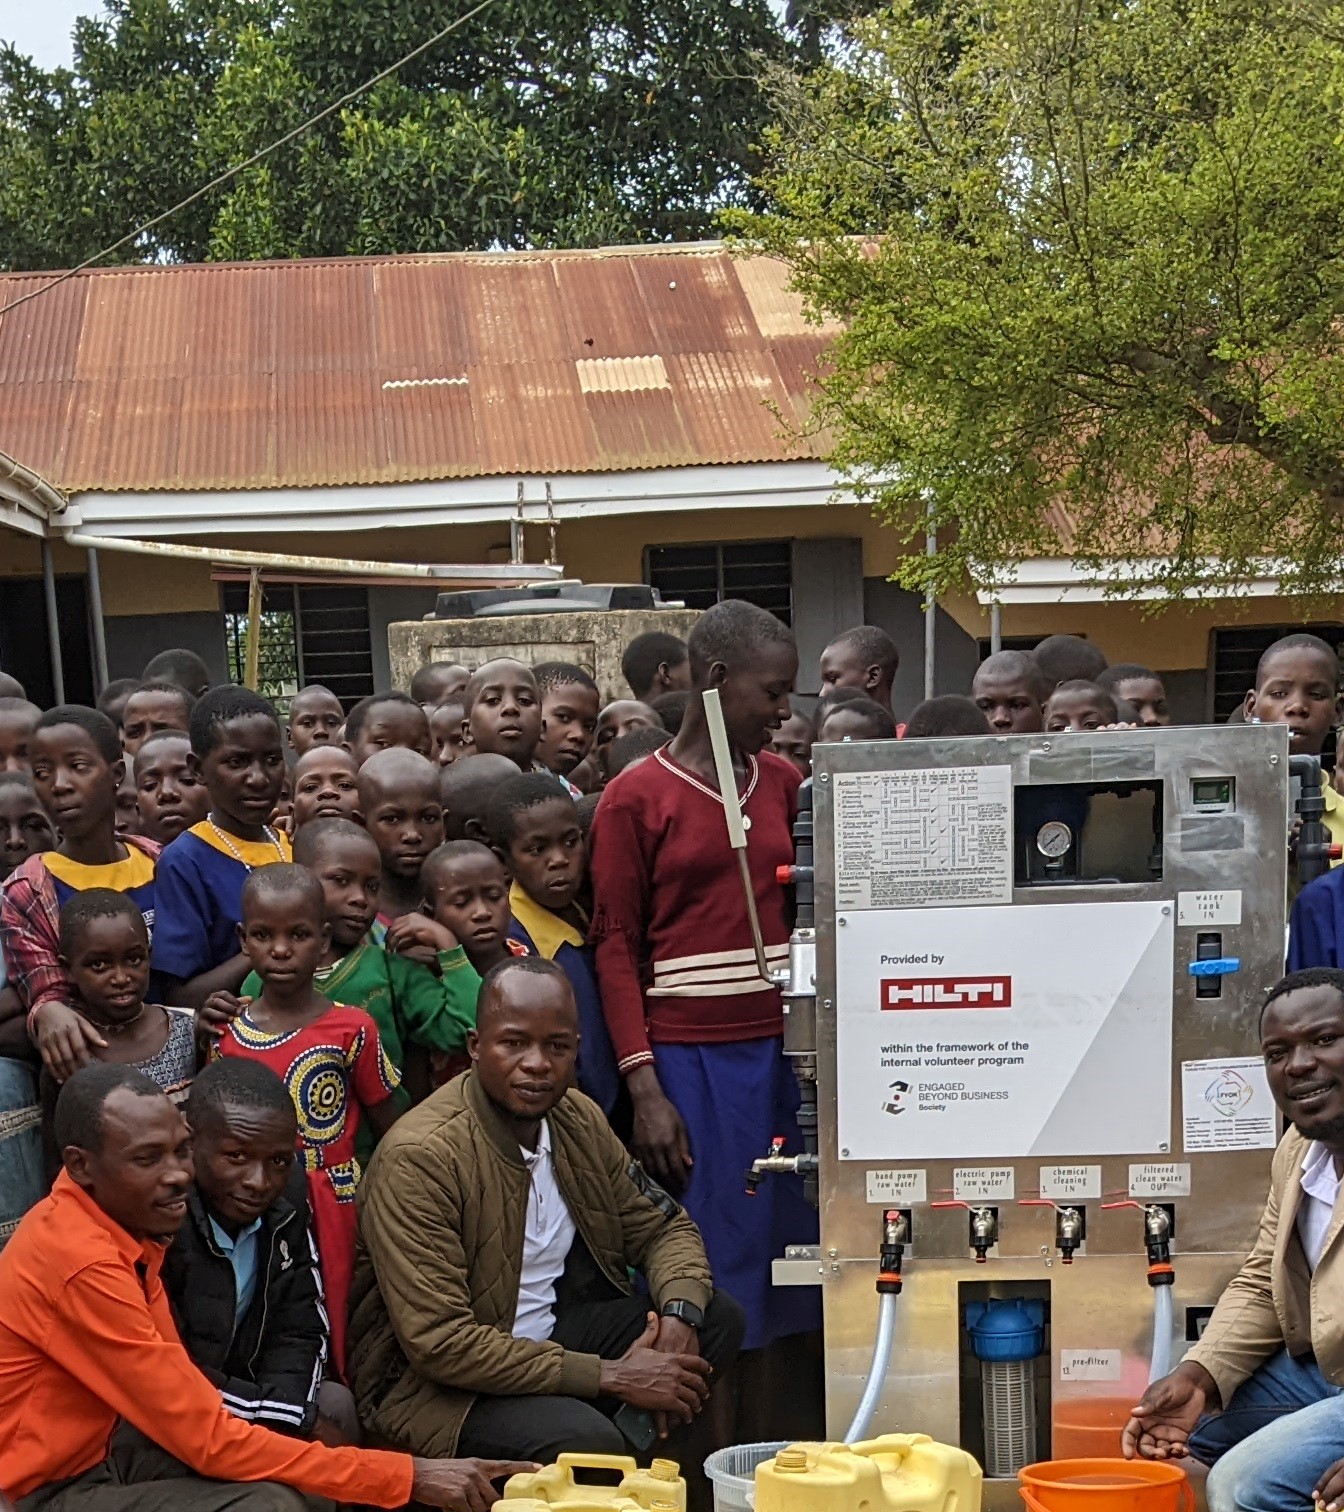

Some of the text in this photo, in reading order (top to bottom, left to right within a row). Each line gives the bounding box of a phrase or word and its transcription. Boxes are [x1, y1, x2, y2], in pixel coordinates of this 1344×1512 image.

[1196, 893, 1223, 901] water
[1198, 901, 1220, 910] tank
[1203, 911, 1214, 919] IN
[880, 954, 944, 965] Provided by
[888, 983, 1004, 1003] HILTI
[881, 1041, 1029, 1053] within the framework of the
[881, 1057, 1024, 1067] internal volunteer program
[918, 1083, 965, 1092] ENGAGED
[918, 1092, 1009, 1100] BEYOND BUSINESS
[1144, 1165, 1174, 1173] filtered
[898, 1173, 918, 1181] pump
[956, 1170, 1011, 1179] electric pump
[1053, 1177, 1086, 1186] cleaning
[1072, 1357, 1108, 1367] pre-filter
